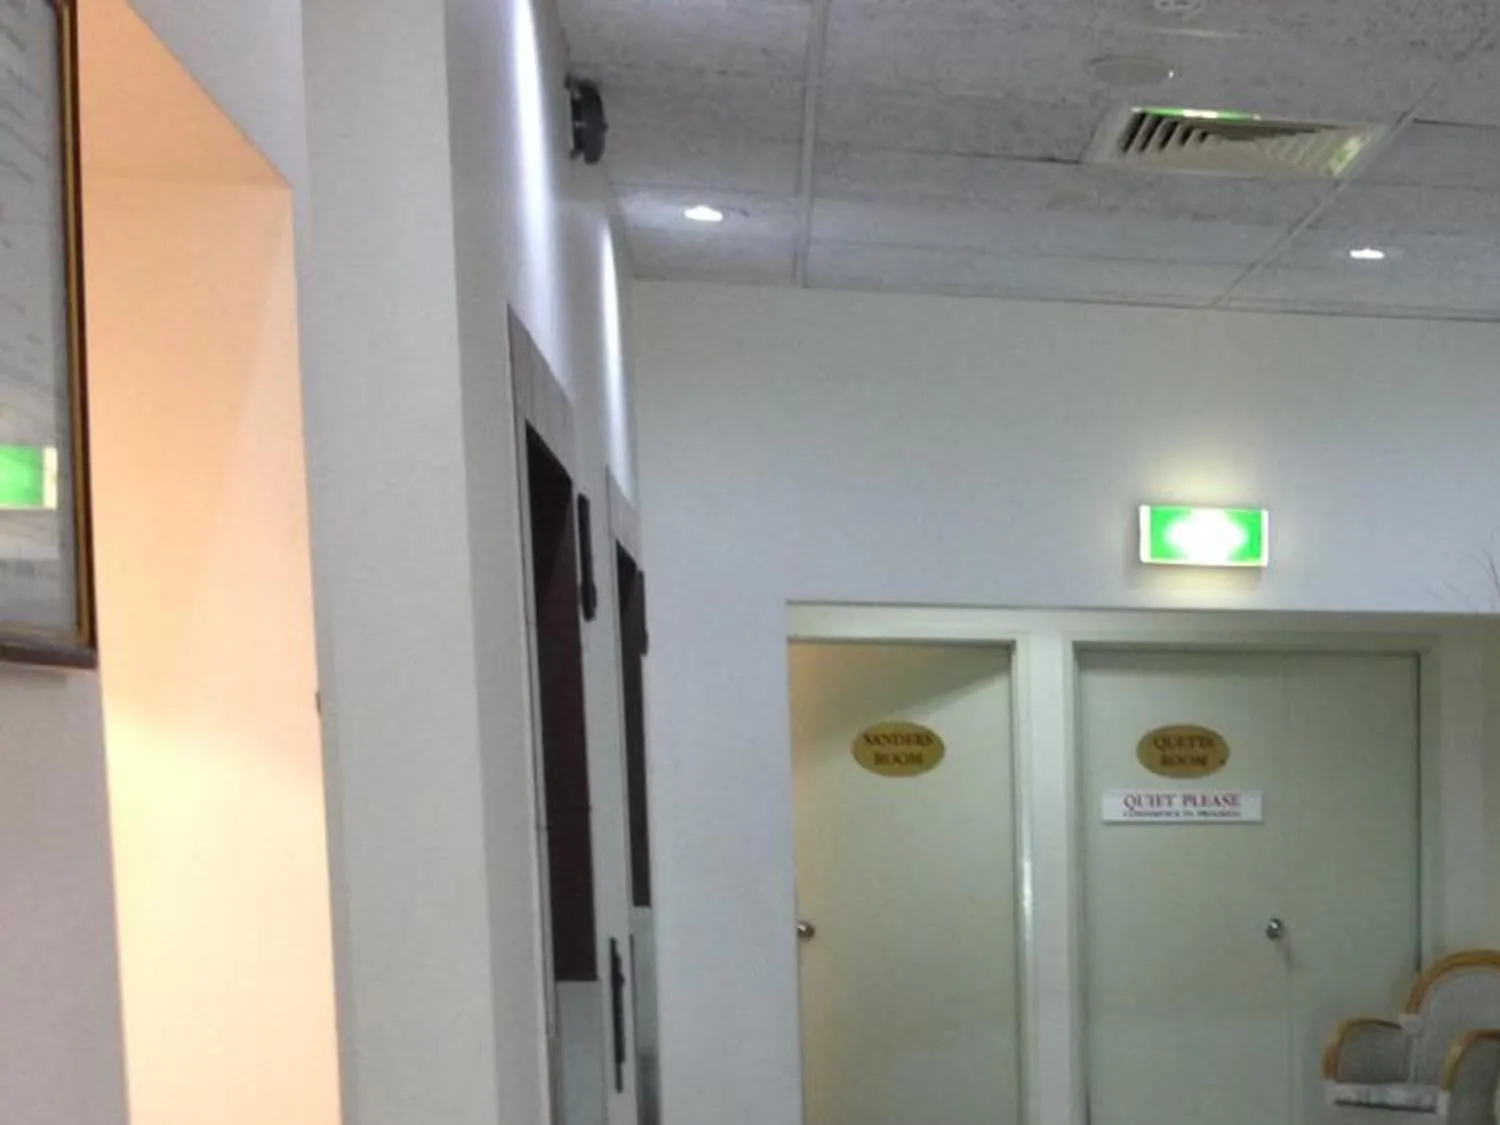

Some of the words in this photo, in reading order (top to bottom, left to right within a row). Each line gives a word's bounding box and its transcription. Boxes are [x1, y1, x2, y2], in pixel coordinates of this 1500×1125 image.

[874, 752, 924, 766] ROOM
[1161, 753, 1209, 767] ROOM
[1123, 792, 1177, 811] QUIET
[1182, 792, 1241, 808] PLEASE
